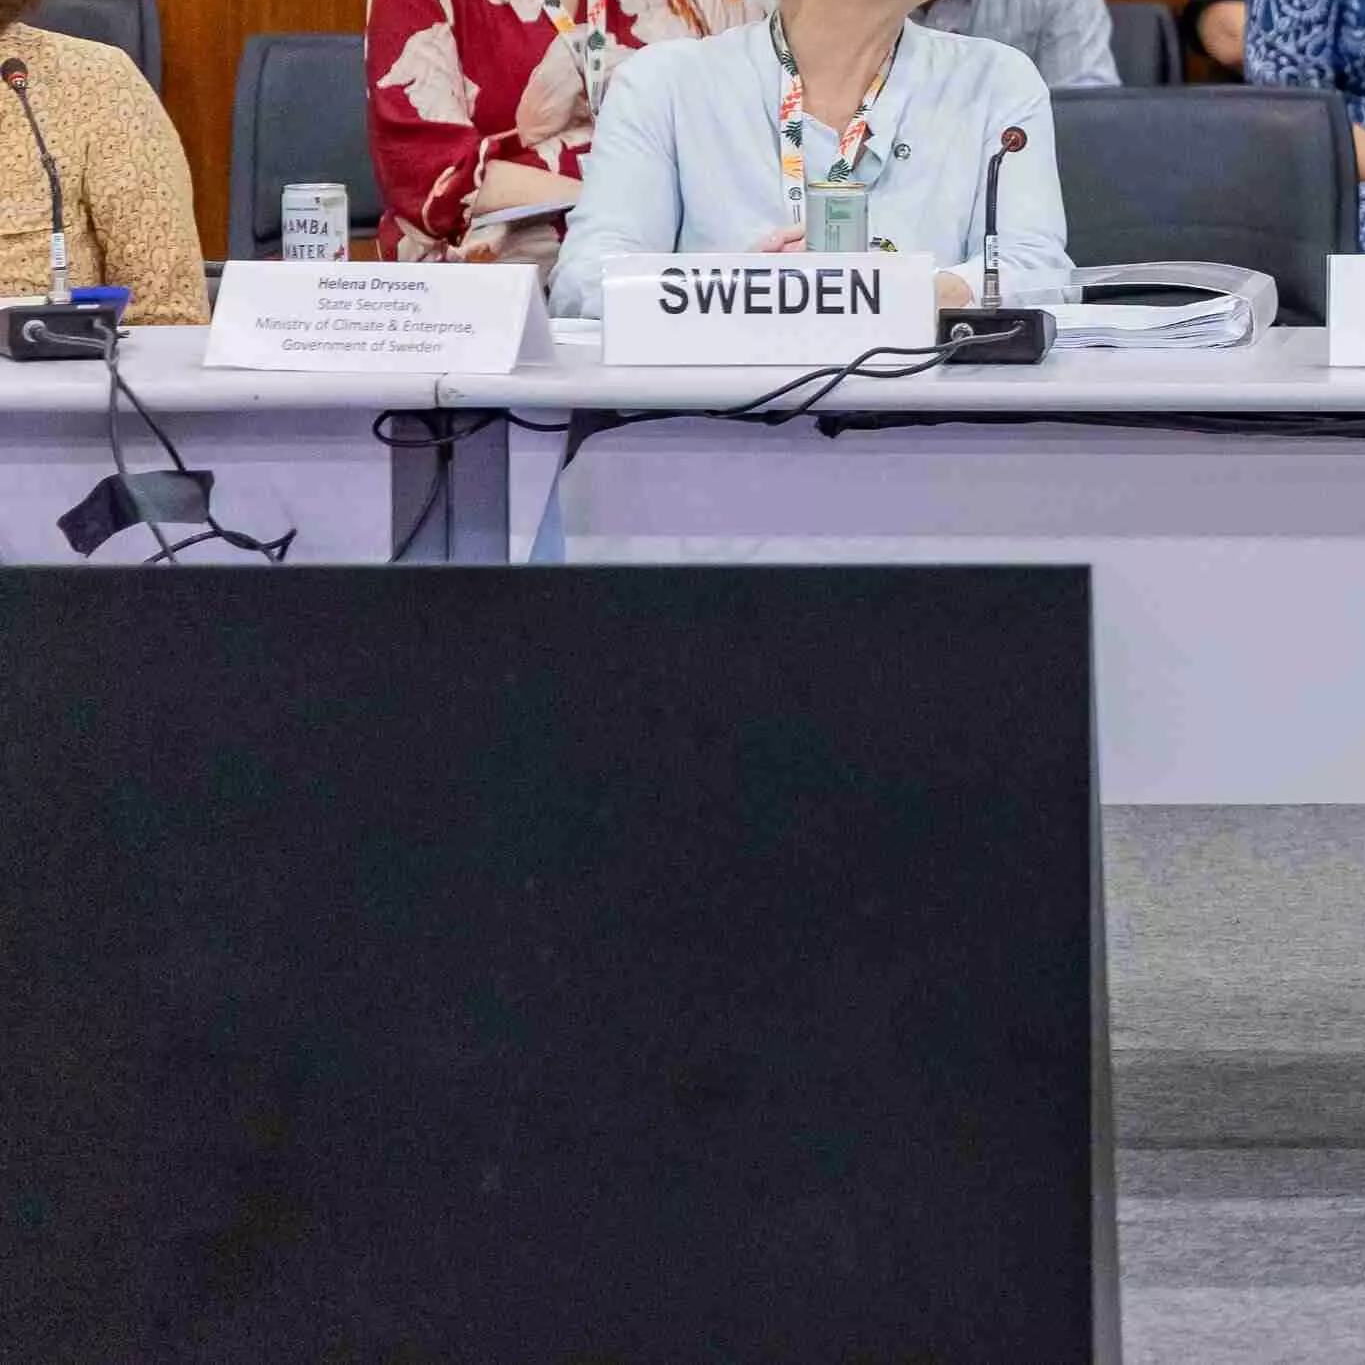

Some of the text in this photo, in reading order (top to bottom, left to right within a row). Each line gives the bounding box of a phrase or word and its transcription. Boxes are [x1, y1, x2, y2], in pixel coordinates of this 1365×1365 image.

[317, 276, 430, 294] Helena Dryssen,
[658, 267, 881, 315] SWEDEN
[317, 297, 422, 314] State Secretary,
[255, 316, 476, 335] Ministry of Climate & Enterprise,
[282, 338, 441, 353] Government of Sweden
